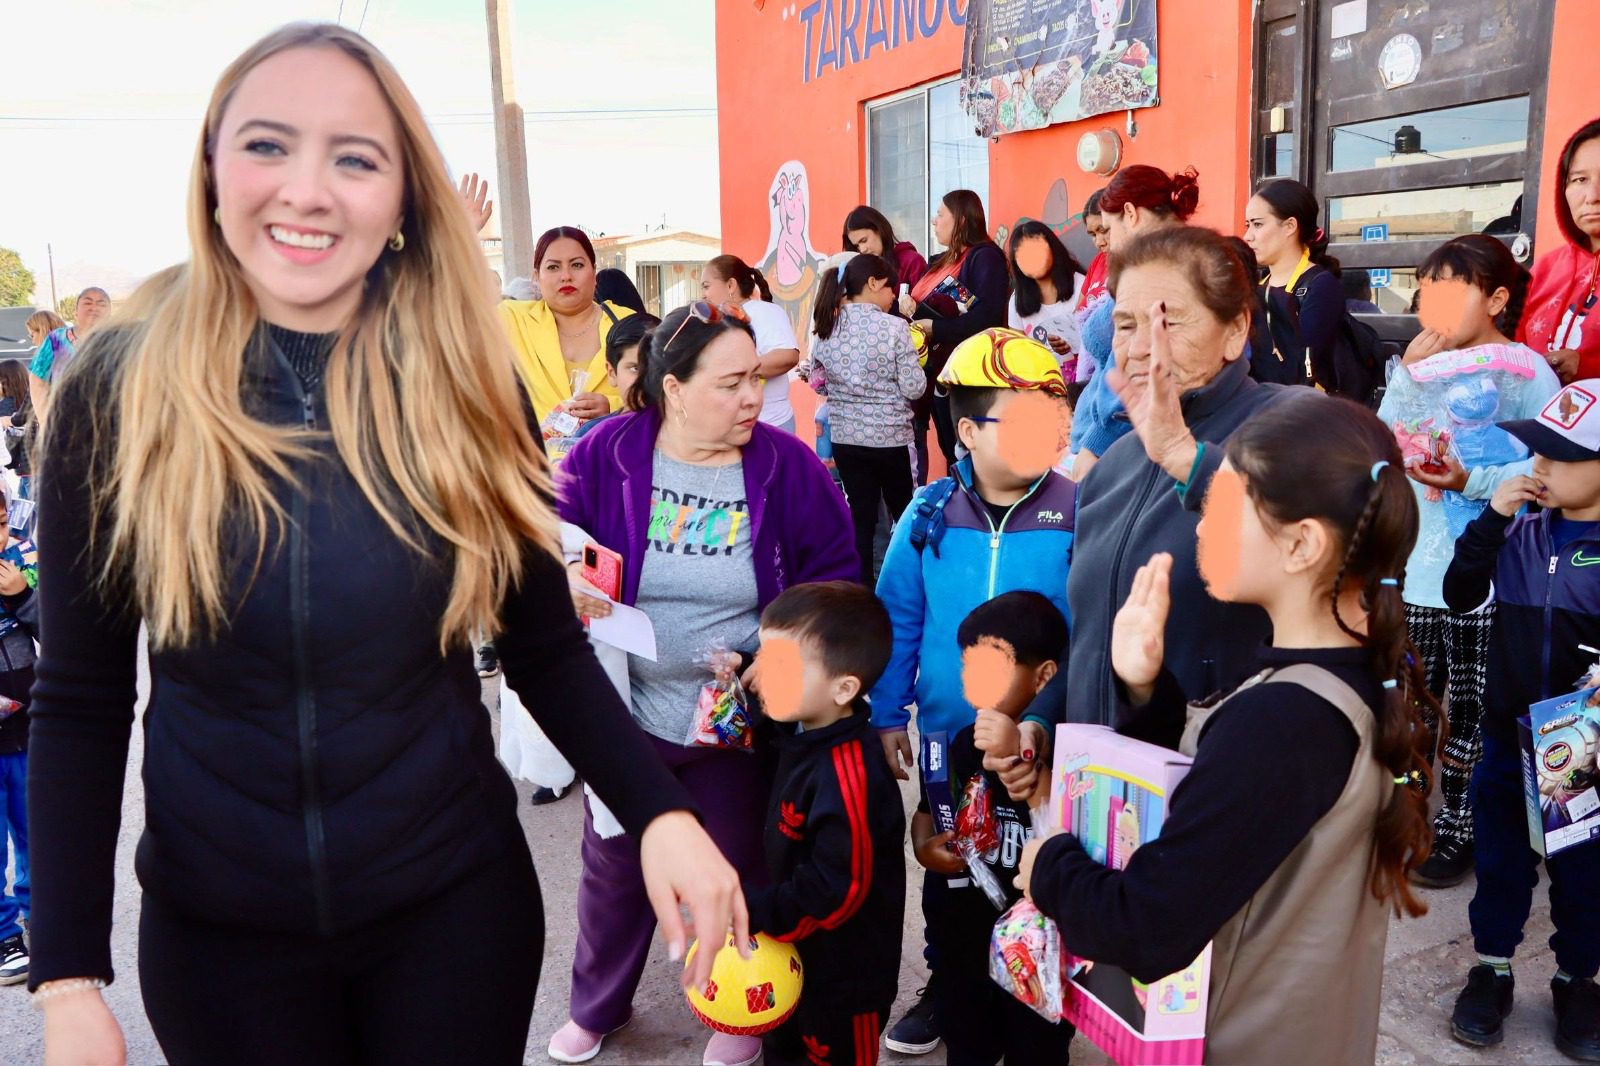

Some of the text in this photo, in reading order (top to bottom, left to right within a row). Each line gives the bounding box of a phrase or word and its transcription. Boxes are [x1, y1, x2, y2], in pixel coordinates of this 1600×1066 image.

[1037, 511, 1064, 520] FILA
[930, 741, 938, 771] SPEED
[1522, 748, 1534, 796] DRIVER
[938, 804, 955, 832] SPEE
